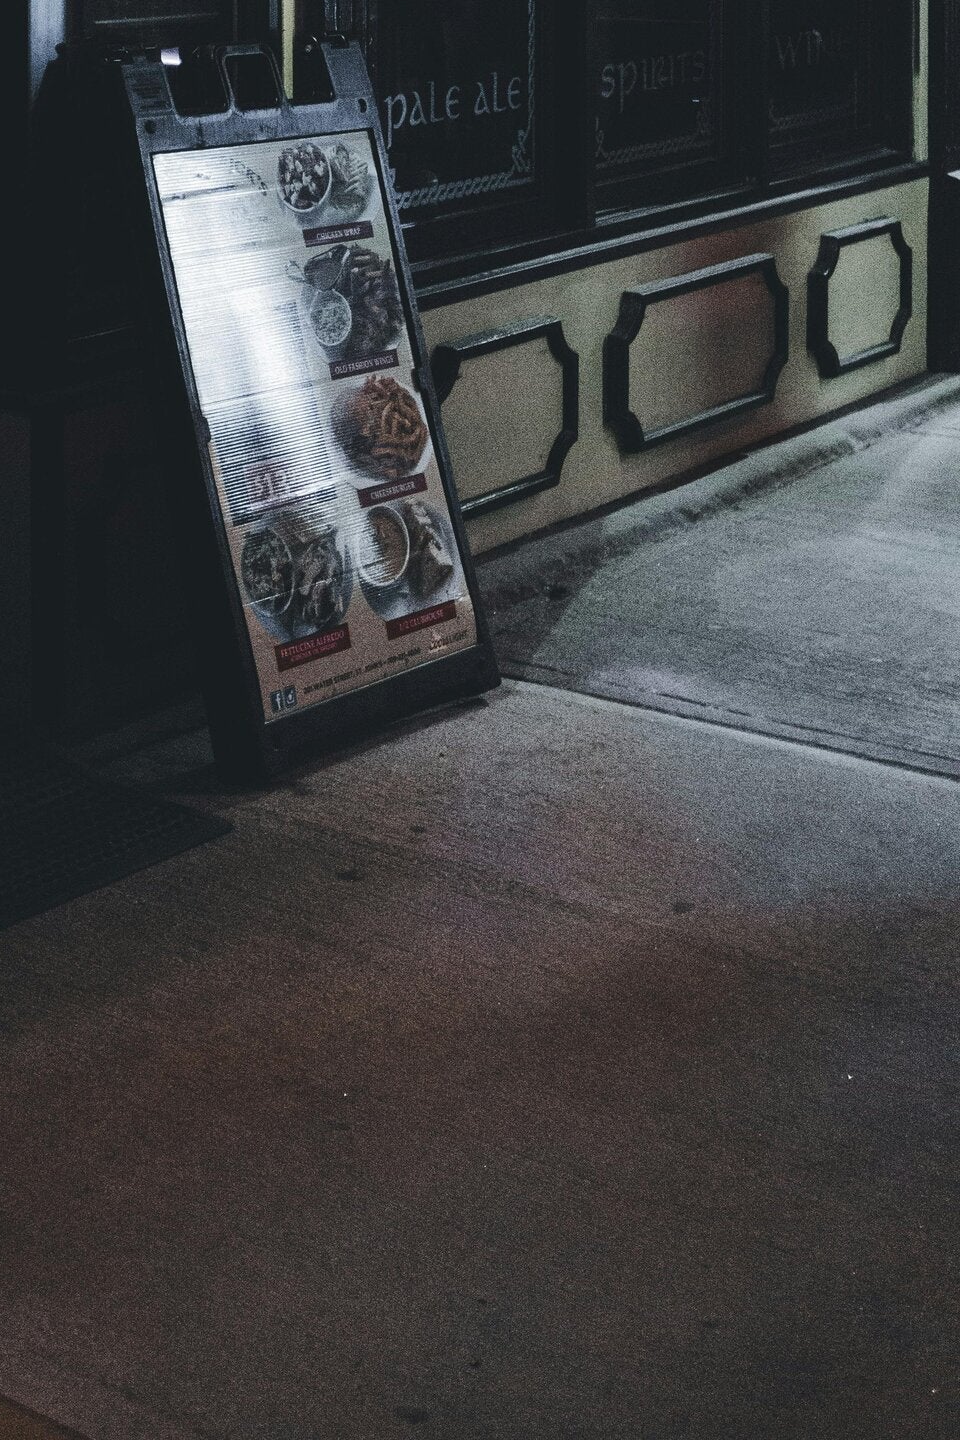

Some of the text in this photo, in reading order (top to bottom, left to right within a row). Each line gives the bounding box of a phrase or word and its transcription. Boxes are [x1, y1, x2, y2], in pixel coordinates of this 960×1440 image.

[334, 354, 395, 375] OLD FASHION WINGS
[370, 481, 416, 500] CHEESEBURGER
[316, 630, 345, 647] ALFREDO
